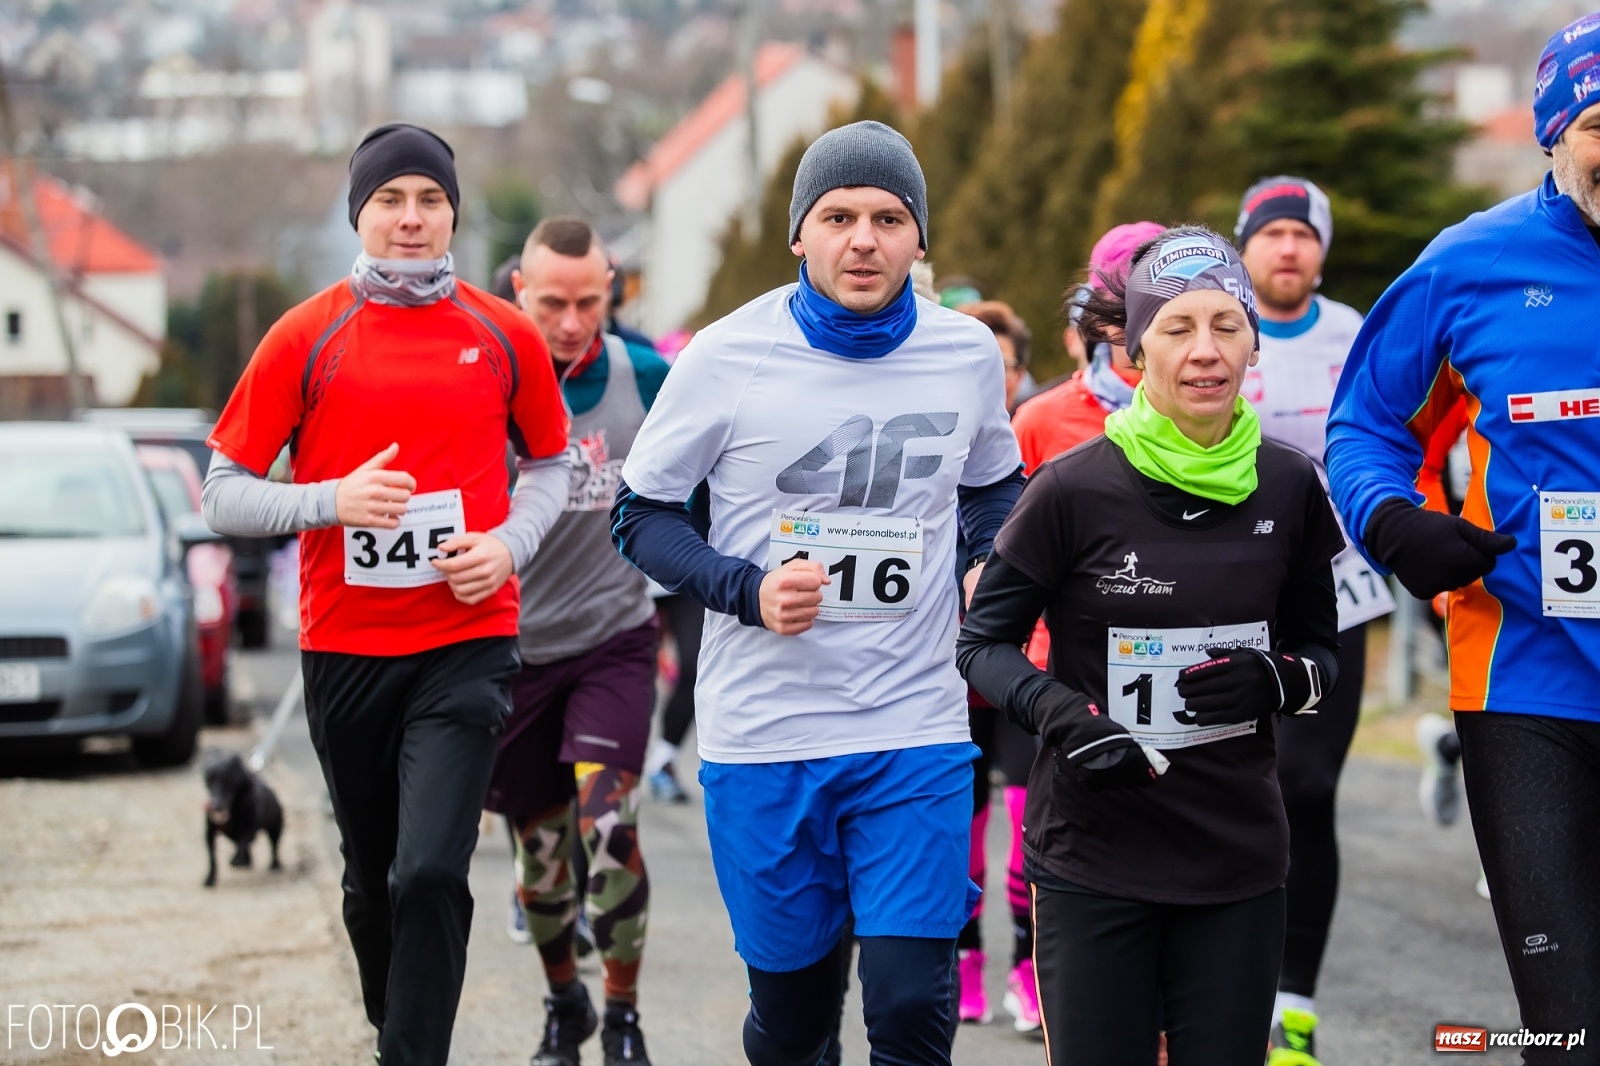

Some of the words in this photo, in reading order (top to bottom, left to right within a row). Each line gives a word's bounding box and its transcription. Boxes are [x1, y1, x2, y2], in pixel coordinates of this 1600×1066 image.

[1154, 247, 1224, 274] ELIMINATOR
[776, 412, 959, 509] 4F
[827, 526, 918, 541] www.personalbest.pl
[352, 526, 458, 569] 345
[781, 550, 911, 604] 16
[1554, 539, 1597, 594] 3
[1142, 582, 1173, 595] Team
[1118, 632, 1163, 642] PersonaBest
[1171, 636, 1264, 653] www.personalbest.pl
